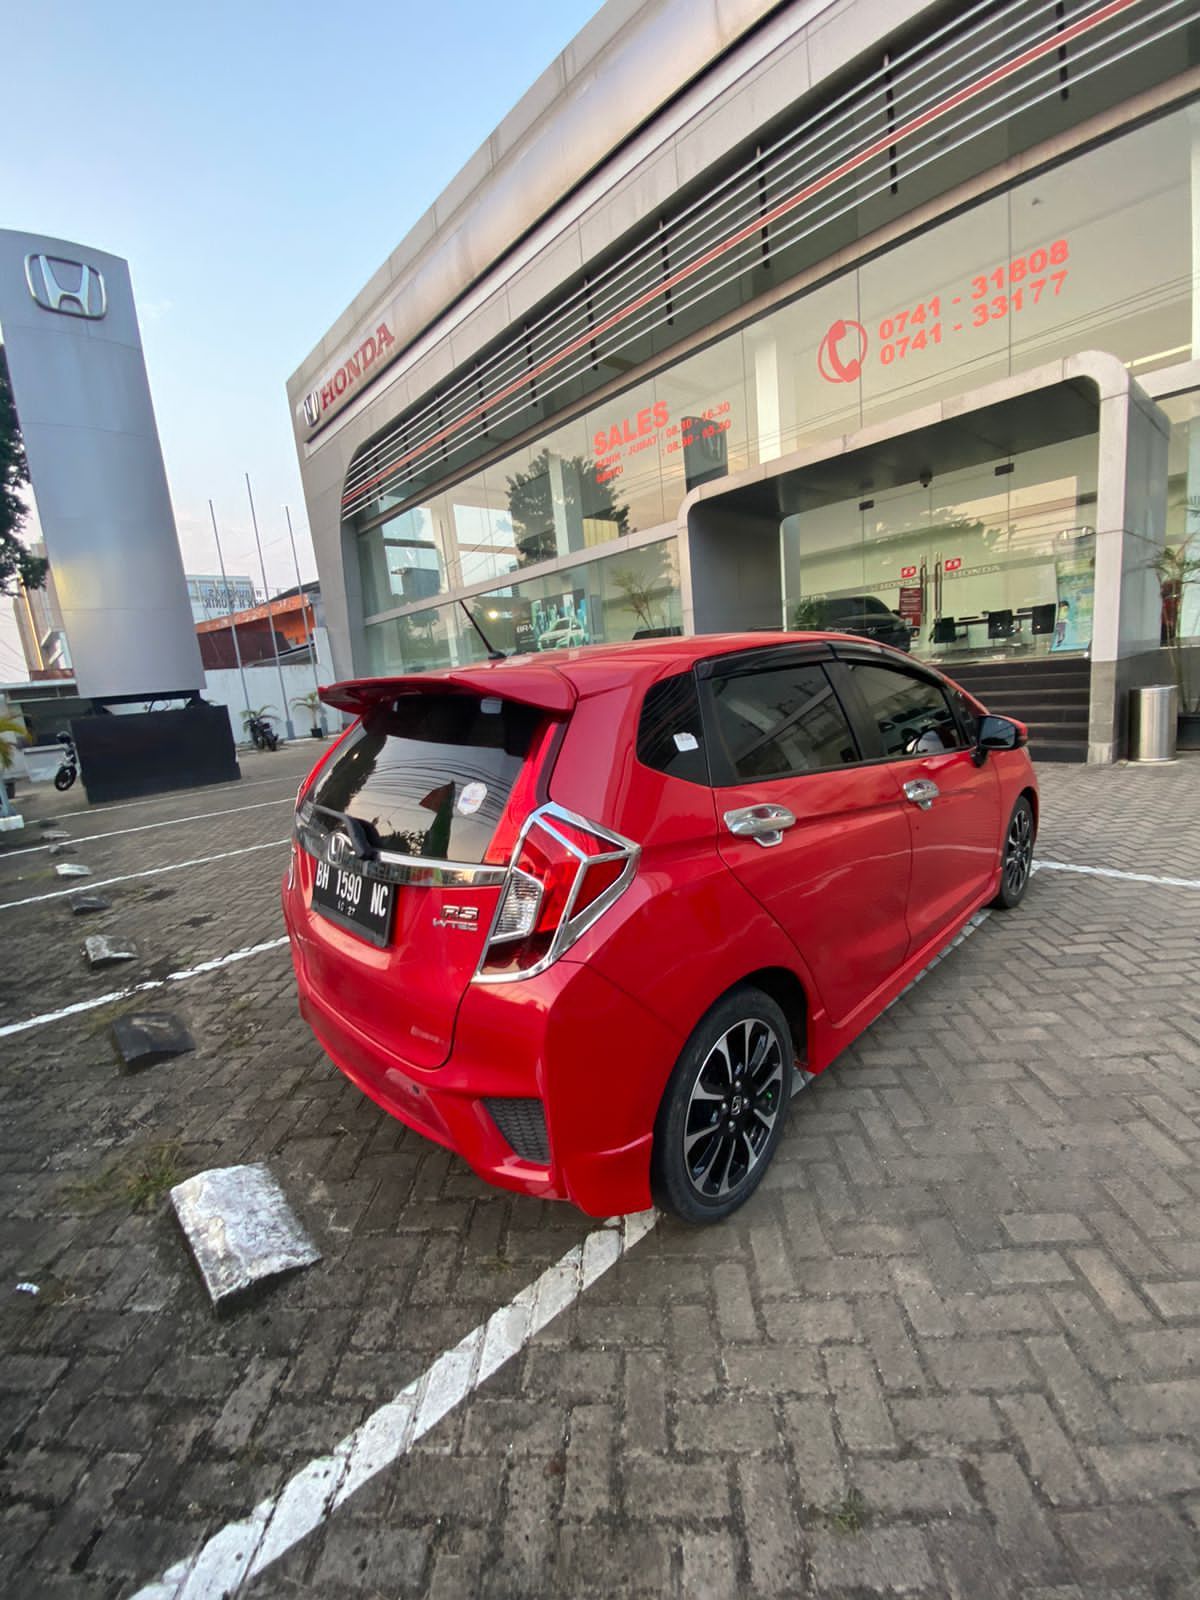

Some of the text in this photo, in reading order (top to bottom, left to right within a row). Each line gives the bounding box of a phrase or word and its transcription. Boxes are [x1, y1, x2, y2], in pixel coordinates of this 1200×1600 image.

[879, 296, 941, 340] 0741
[970, 239, 1069, 300] 31808
[879, 322, 942, 365] 0741
[972, 269, 1069, 328] 33177
[320, 322, 395, 411] HONDA
[593, 400, 670, 456] SALES
[316, 861, 388, 917] BH 1590 NC
[442, 904, 478, 920] RS
